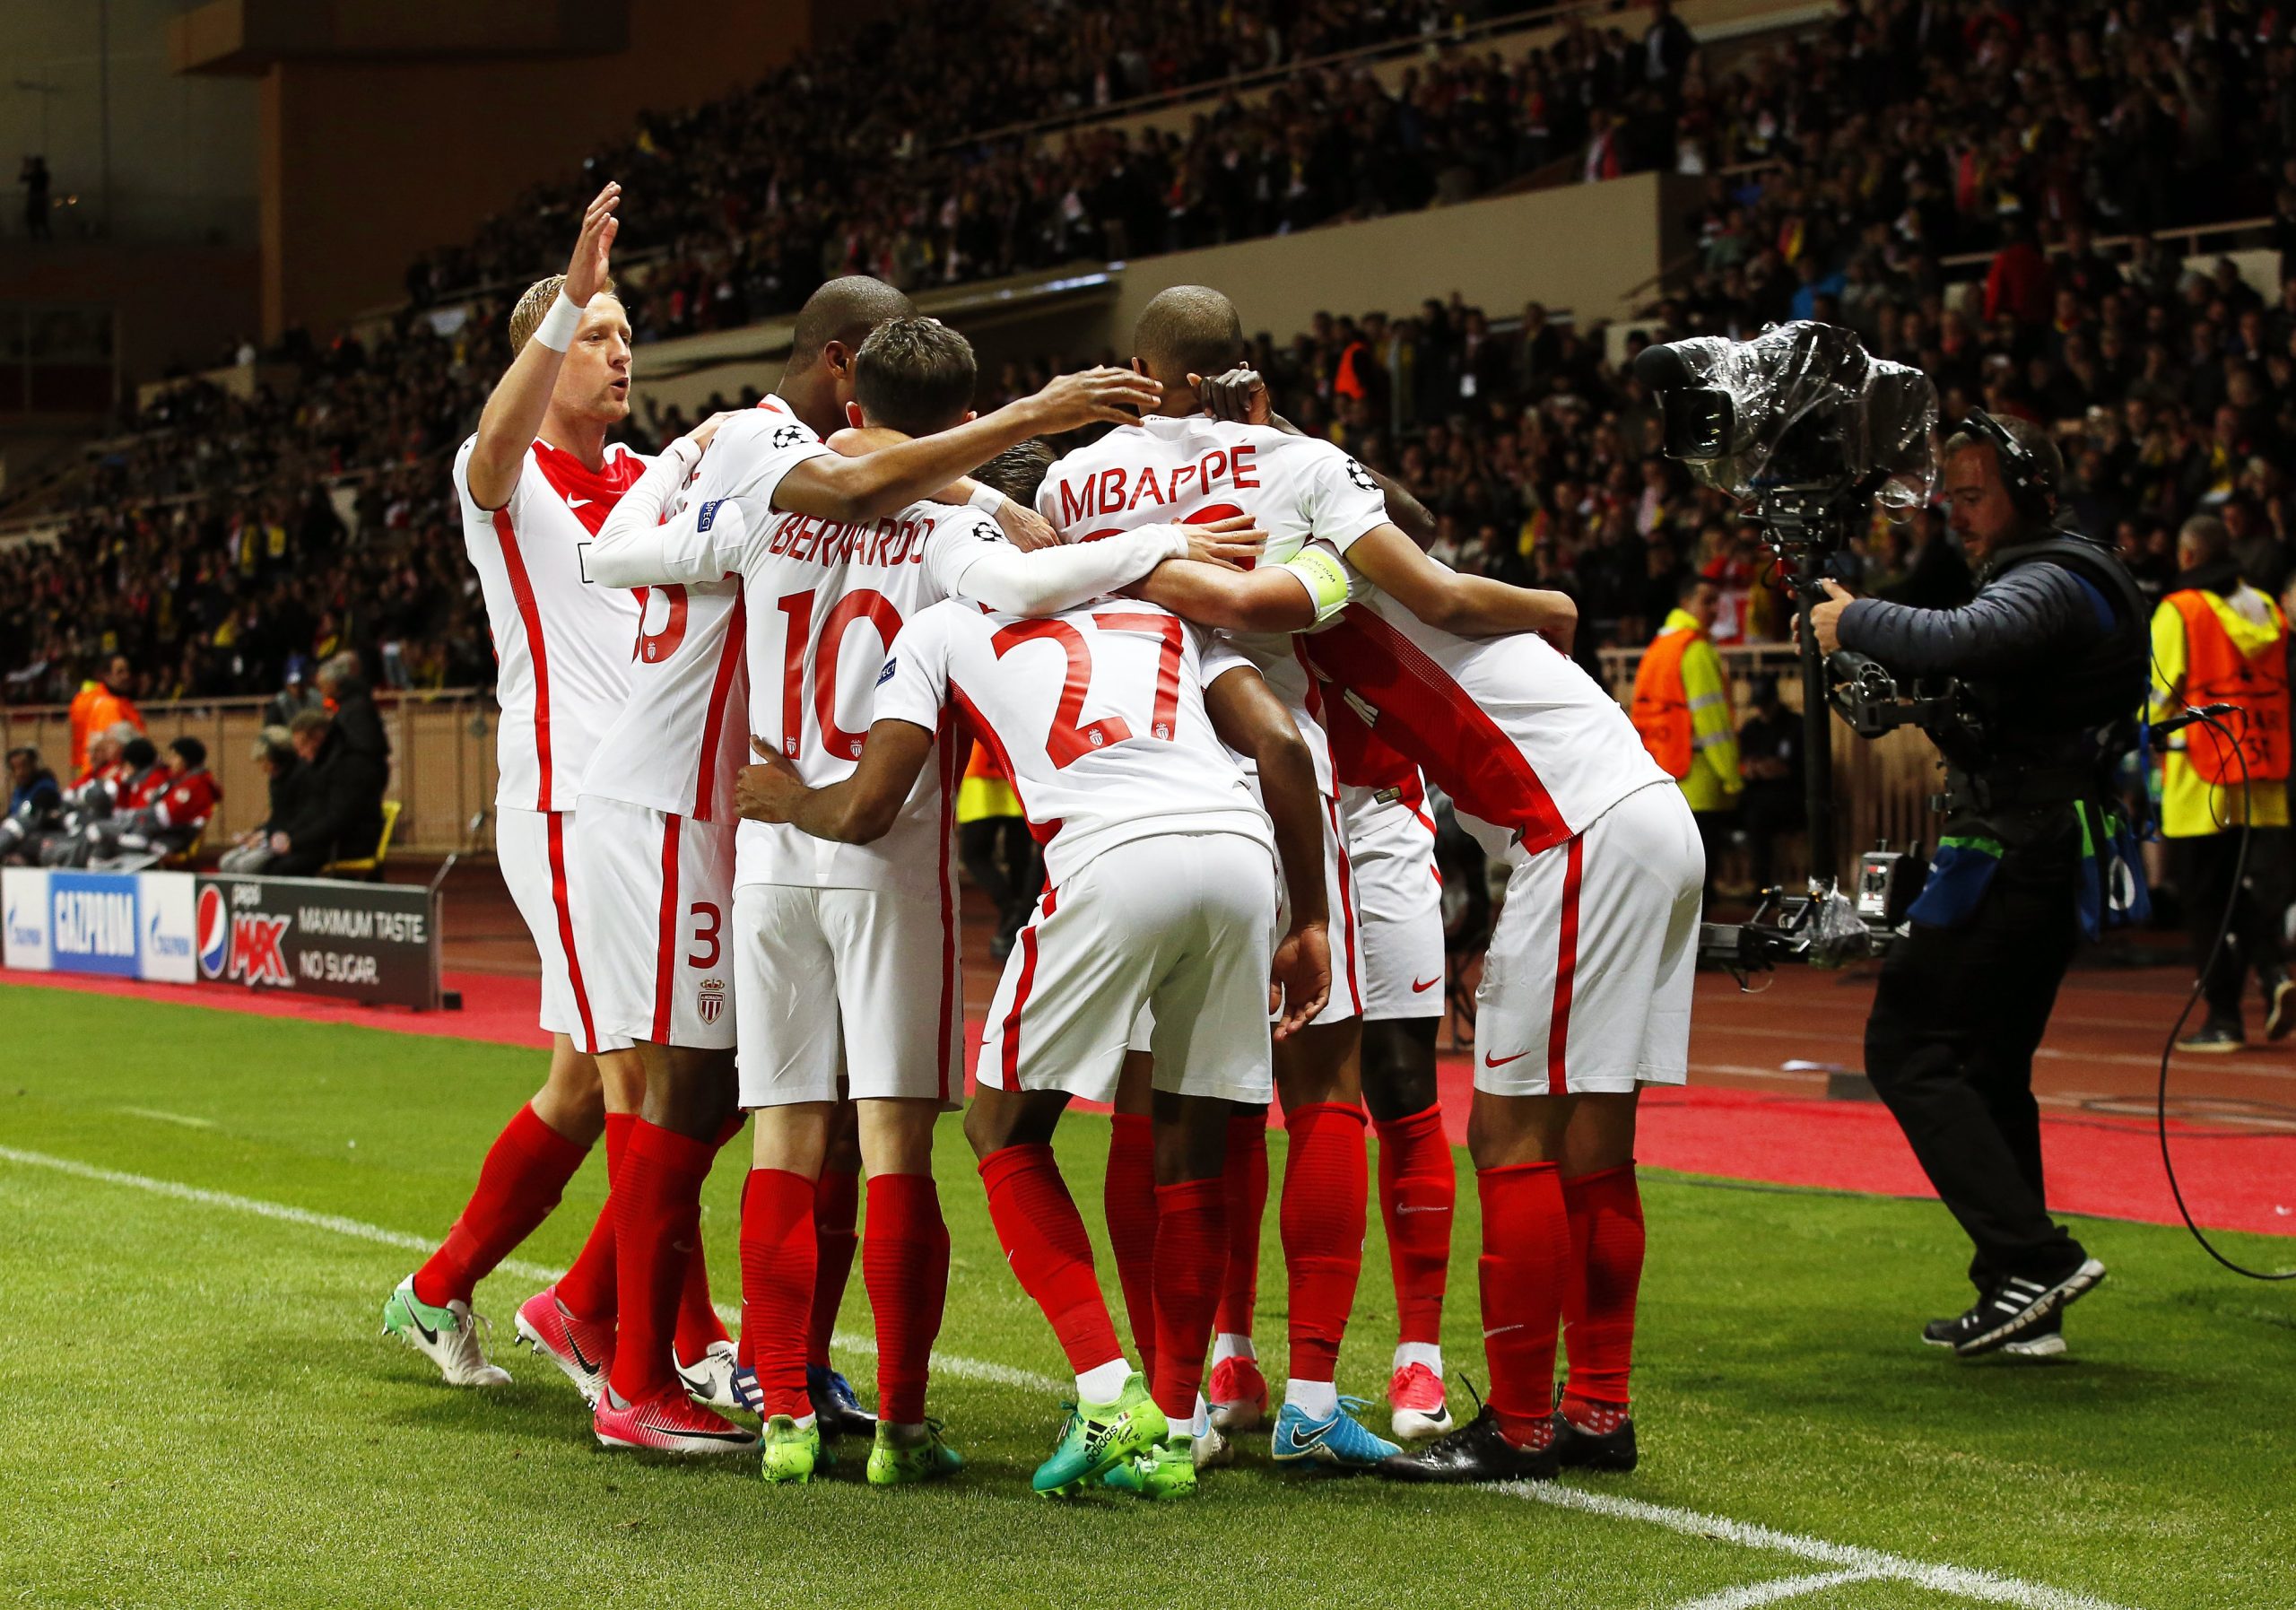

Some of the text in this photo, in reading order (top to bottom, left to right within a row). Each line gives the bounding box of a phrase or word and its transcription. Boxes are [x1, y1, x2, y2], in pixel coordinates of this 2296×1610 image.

[1059, 438, 1261, 528] MBAPPÉ
[777, 587, 904, 762] 10
[990, 613, 1185, 770] 27
[55, 890, 135, 957] GAZPROM
[228, 910, 296, 987] MAX
[298, 906, 373, 939] MAXIMUM
[688, 901, 722, 970] 3
[299, 949, 325, 980] NO
[1085, 1424, 1118, 1464] adidas
